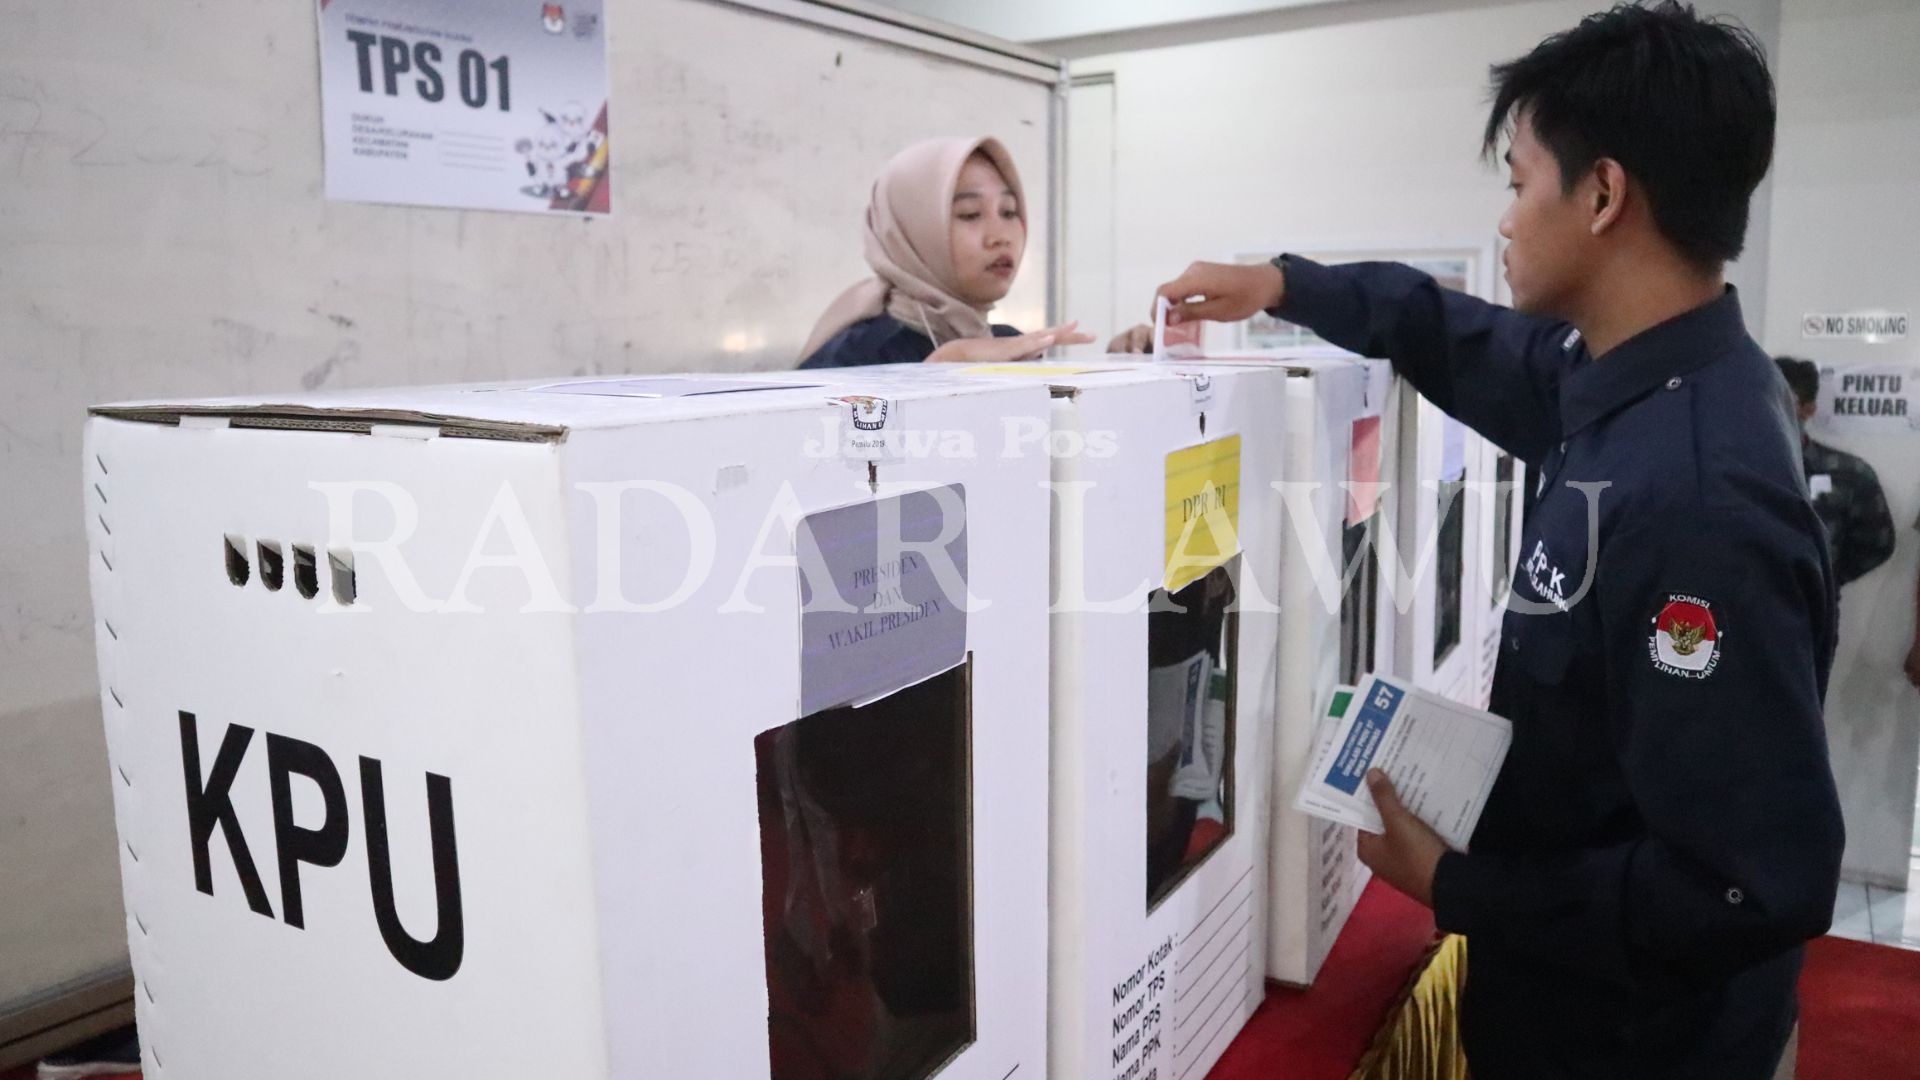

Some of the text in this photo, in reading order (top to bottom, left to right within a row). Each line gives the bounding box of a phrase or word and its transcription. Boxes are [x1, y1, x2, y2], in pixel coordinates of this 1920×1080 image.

[346, 29, 511, 112] TPS 01
[1826, 317, 1907, 336] NO SMOKING
[1842, 375, 1902, 393] PINTU
[1834, 397, 1908, 416] KELUAR
[1183, 484, 1227, 523] DPR RI
[853, 555, 918, 589] PRESIDEN
[873, 586, 902, 610] DAN
[1669, 593, 1711, 609] KOMISI
[829, 599, 941, 650] WAKIL PRESIDEN
[1648, 636, 1721, 680] PEMILIHAN UMUM
[1374, 685, 1395, 710] 57
[178, 710, 464, 982] KPU
[1112, 934, 1173, 1007] Nomor Kotak
[1112, 970, 1165, 1038] Nomor TPS
[1112, 1002, 1160, 1068] Nama PPS
[1142, 1029, 1161, 1066] PPK
